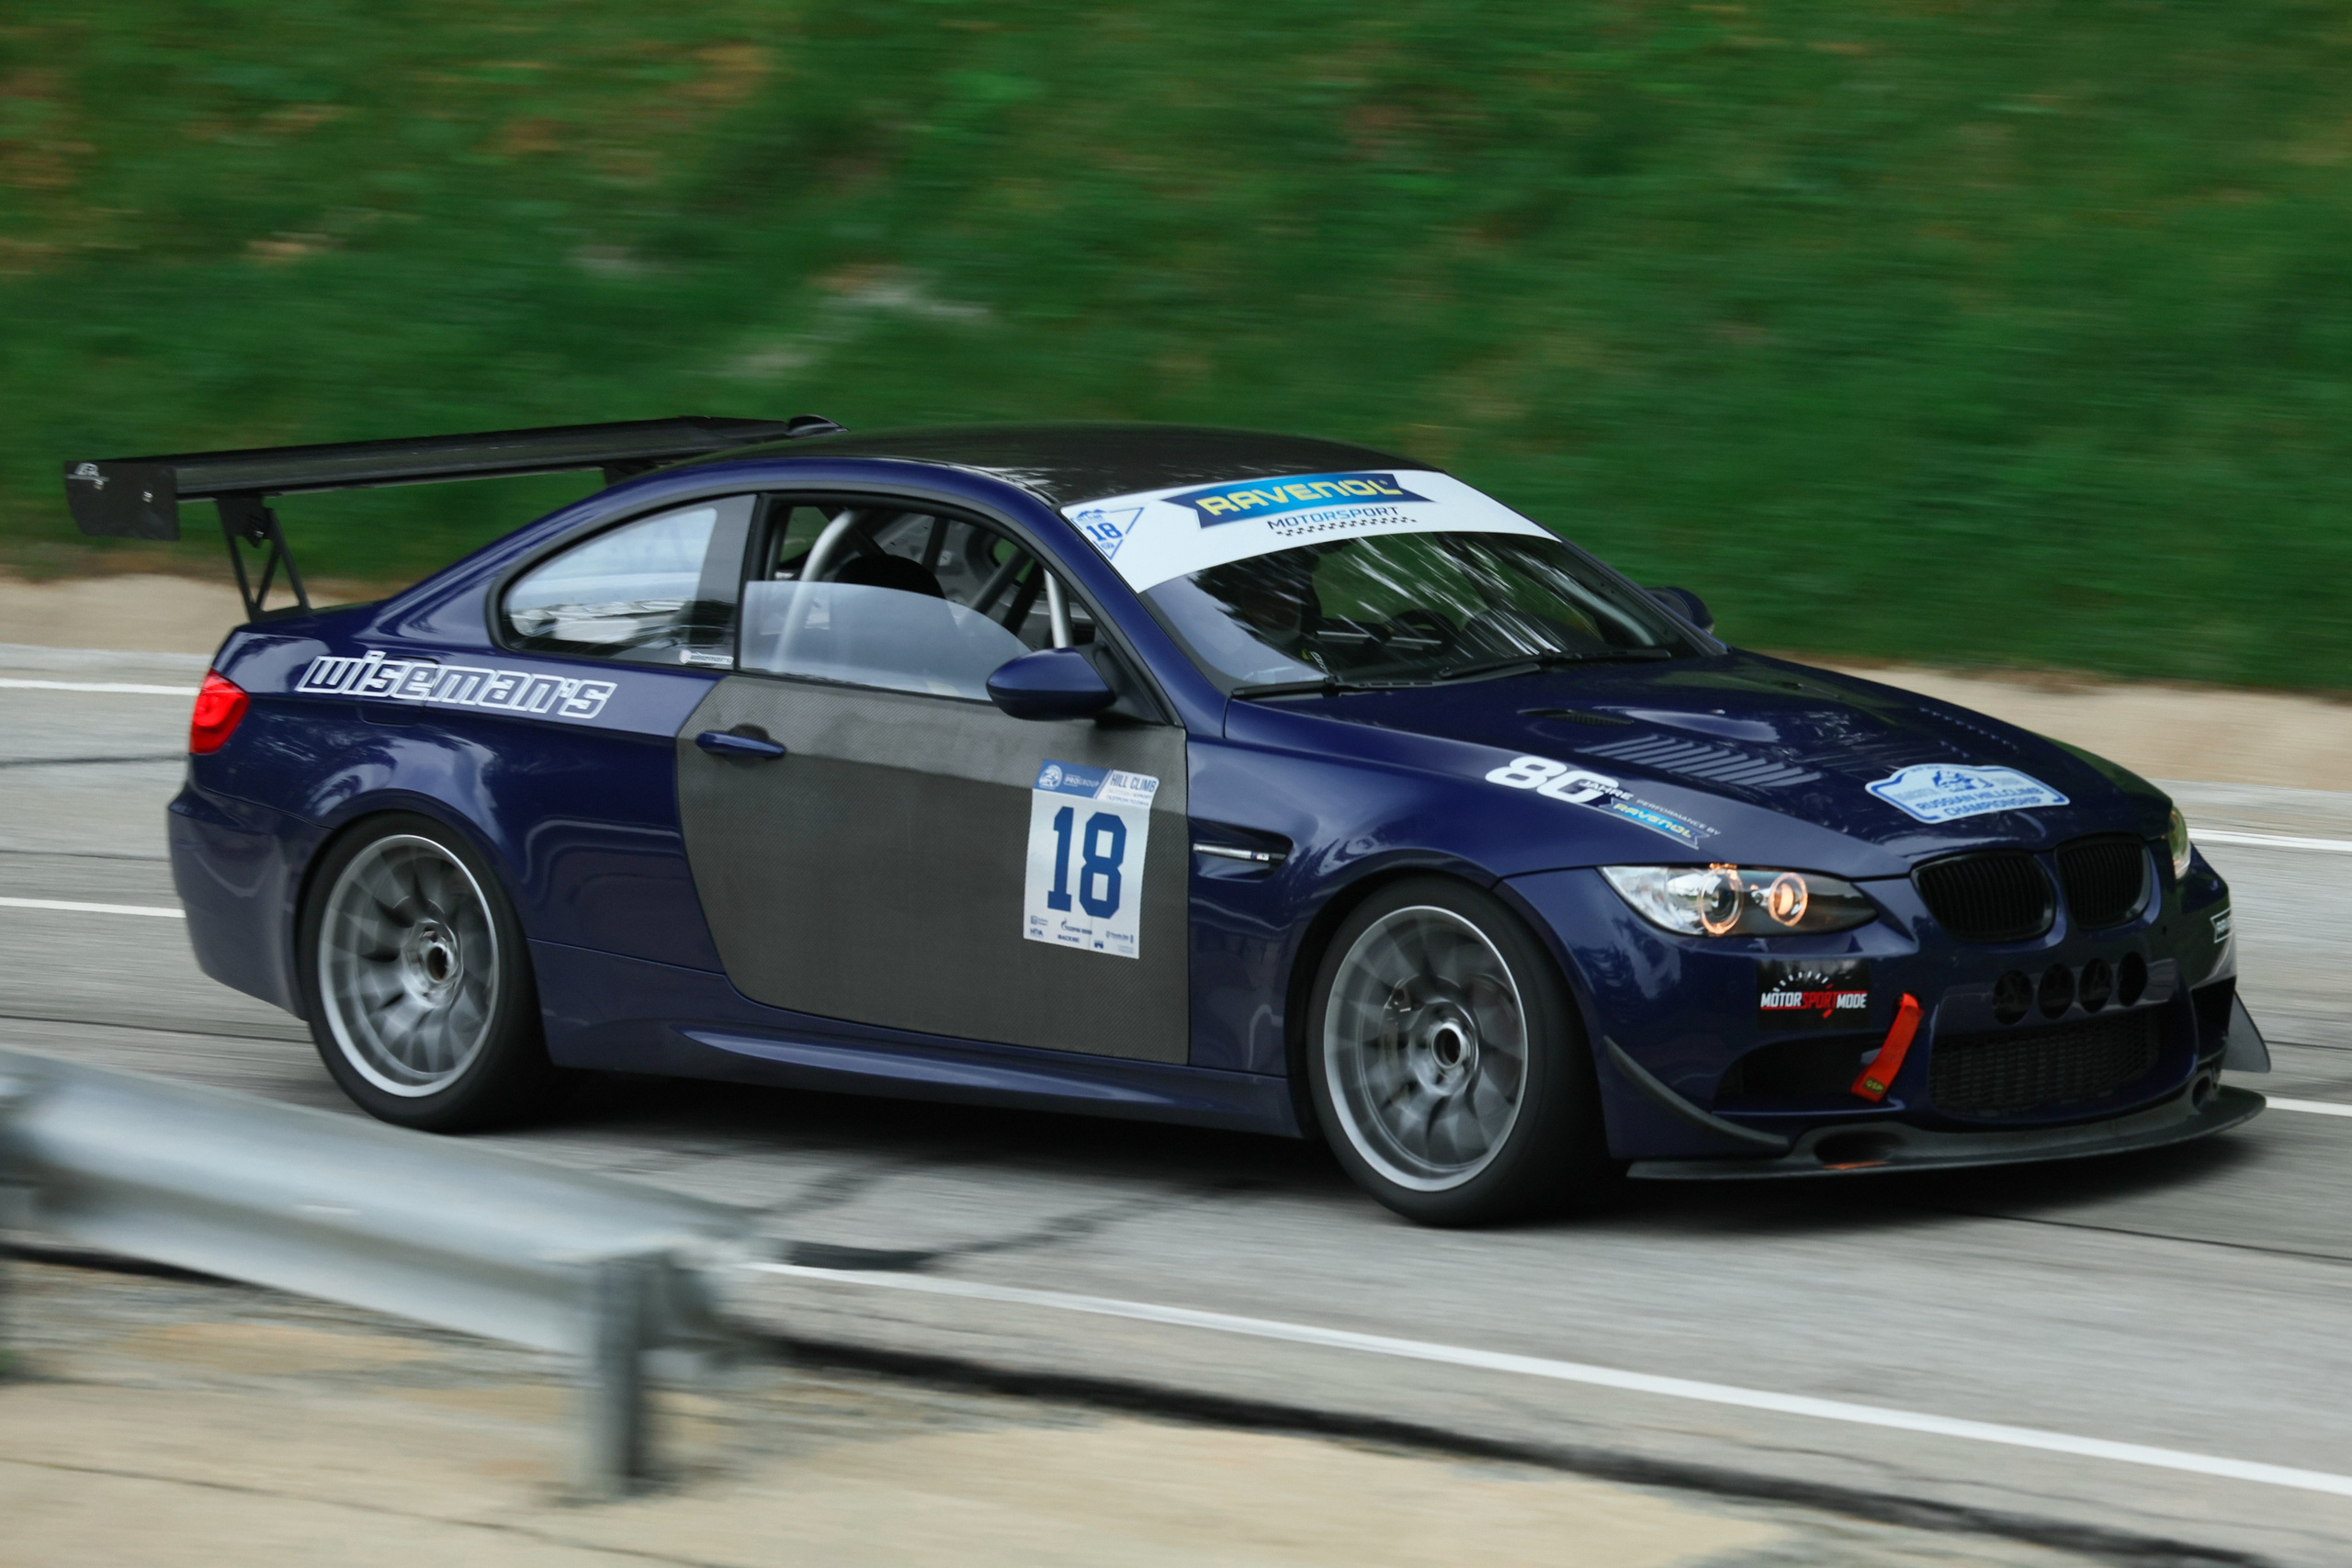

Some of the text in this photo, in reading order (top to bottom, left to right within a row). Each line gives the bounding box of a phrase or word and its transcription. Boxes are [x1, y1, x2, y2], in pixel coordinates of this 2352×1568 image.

[1195, 479, 1404, 515] RAVENOL
[1267, 506, 1398, 530] MOTORSPORT
[1086, 523, 1123, 541] 18
[1110, 773, 1158, 792] HILL CLIMB
[1578, 781, 1634, 800] JAHRE
[1915, 793, 1974, 811] RUSSIAN
[1943, 796, 2041, 817] CHAMPIONSHIP
[1613, 803, 1691, 838] RAVENOL
[1636, 799, 1721, 835] PERFORMANCE BY
[1047, 806, 1126, 919] 18
